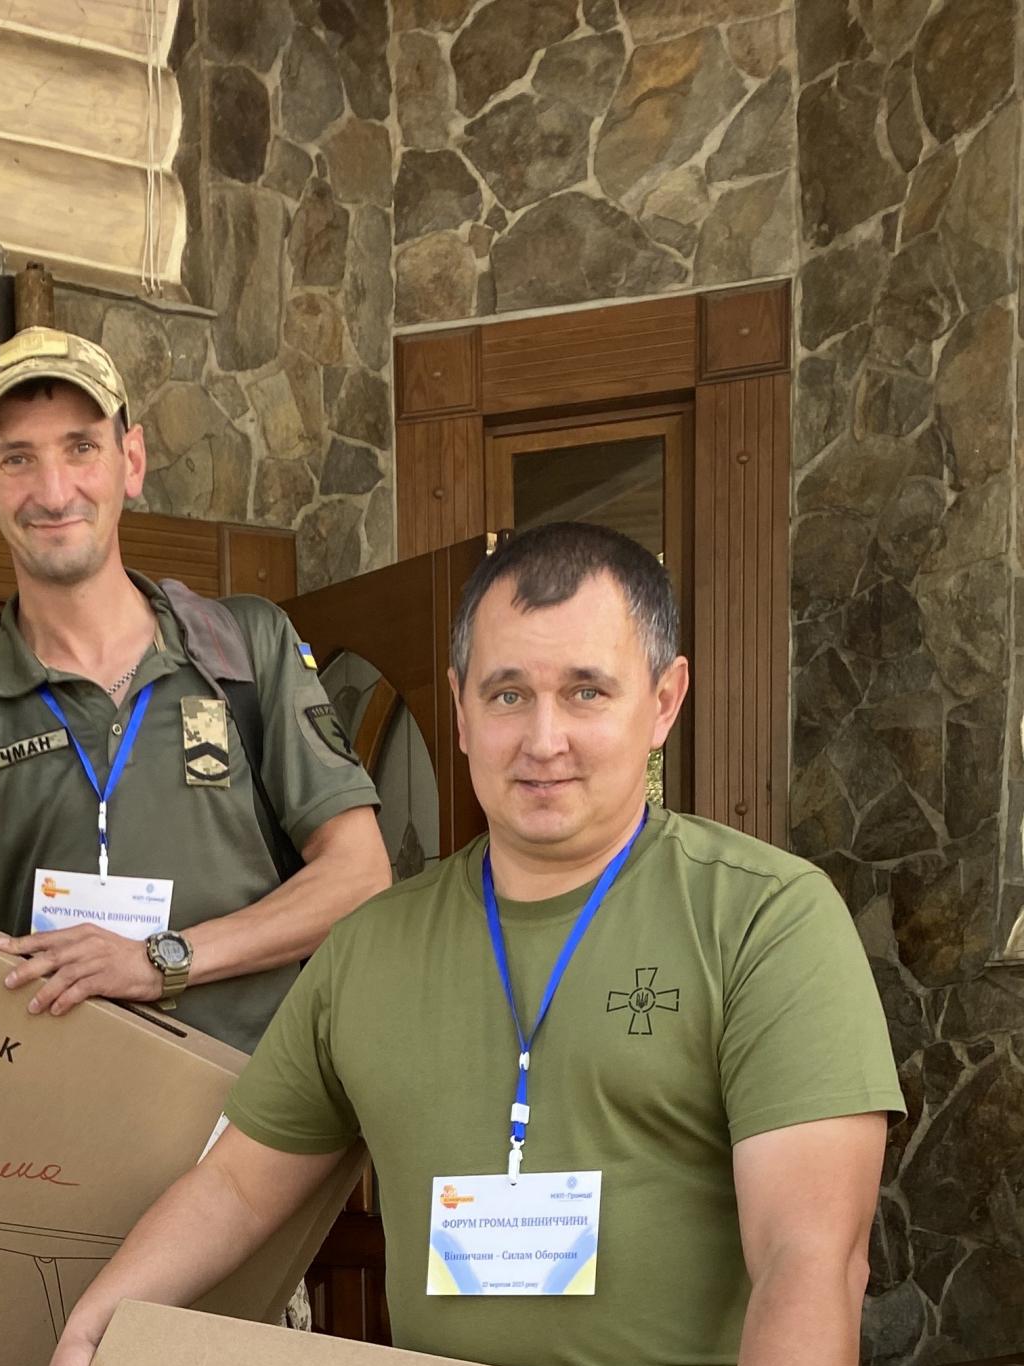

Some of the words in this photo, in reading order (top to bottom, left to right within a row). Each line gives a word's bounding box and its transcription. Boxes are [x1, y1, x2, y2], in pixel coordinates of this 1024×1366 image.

[42, 906, 71, 917] ФОРУМ
[73, 909, 106, 920] ГРОМАД
[442, 1218, 477, 1229] ФОРУМ
[479, 1217, 519, 1228] ГРОМАД
[521, 1216, 588, 1227] ВІННИЧЧИНИ
[502, 1251, 533, 1260] Силам
[535, 1249, 578, 1261] Оборони
